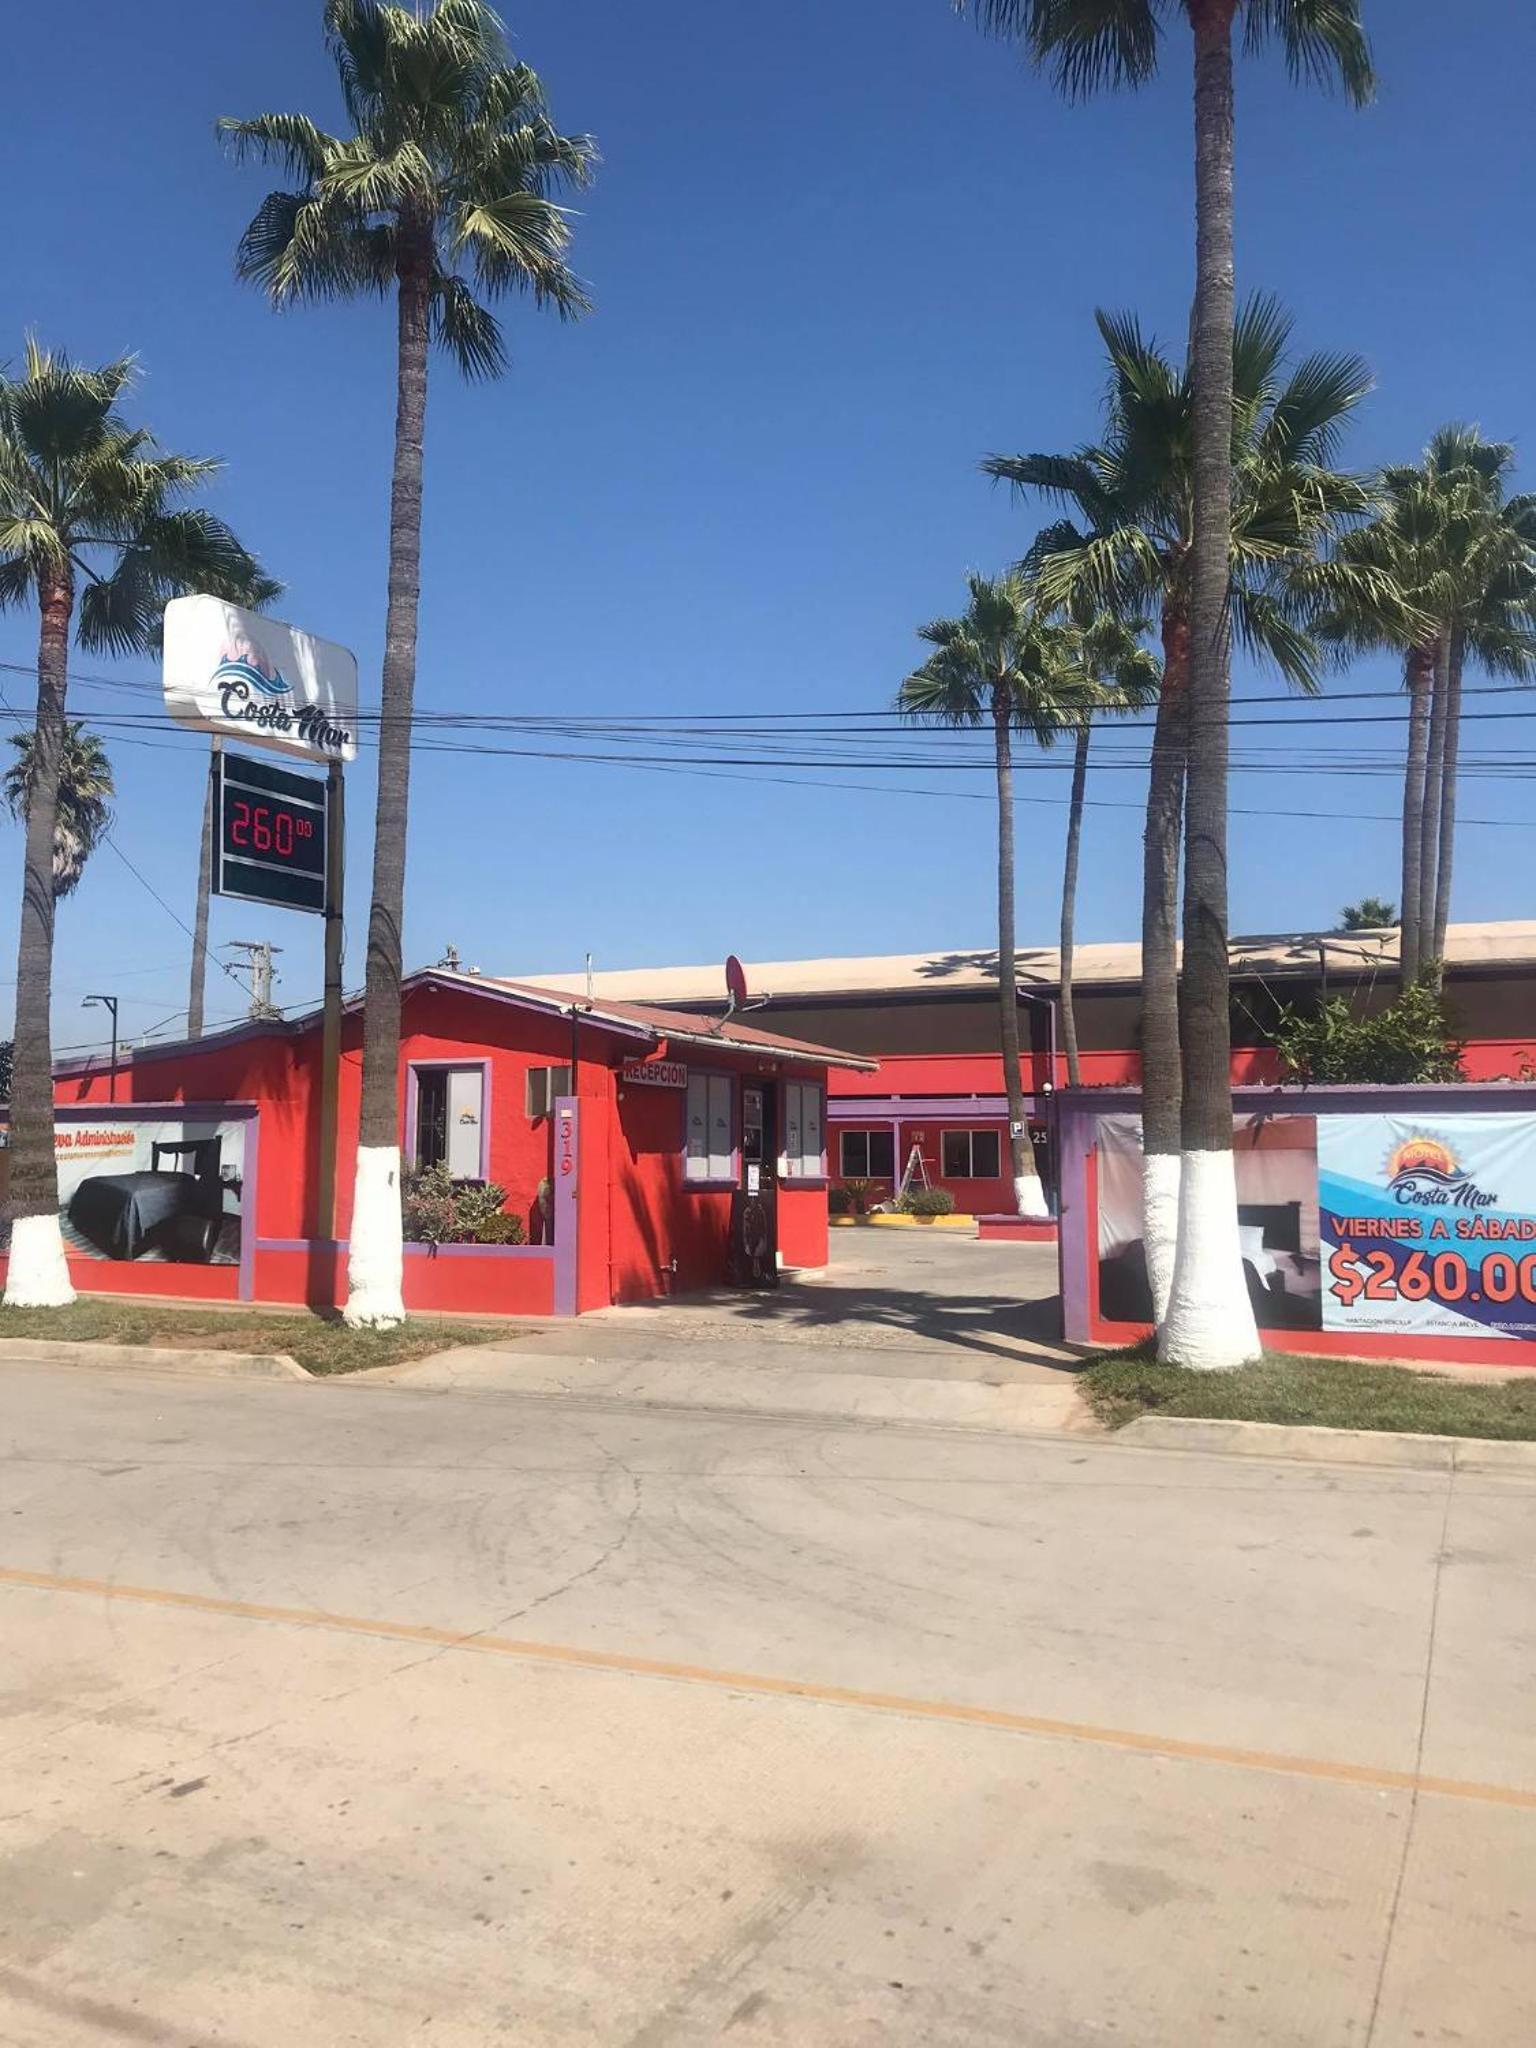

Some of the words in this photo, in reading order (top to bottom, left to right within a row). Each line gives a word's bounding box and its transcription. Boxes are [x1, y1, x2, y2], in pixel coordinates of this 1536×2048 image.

[218, 681, 292, 732] Costa
[292, 704, 350, 749] Mar
[231, 802, 293, 855] 260
[54, 1133, 72, 1148] eva
[1033, 1131, 1048, 1144] 25
[1393, 1181, 1449, 1206] Costa
[1450, 1182, 1498, 1210] Mar
[1331, 1217, 1423, 1238] VIERNES
[1429, 1218, 1450, 1239] A
